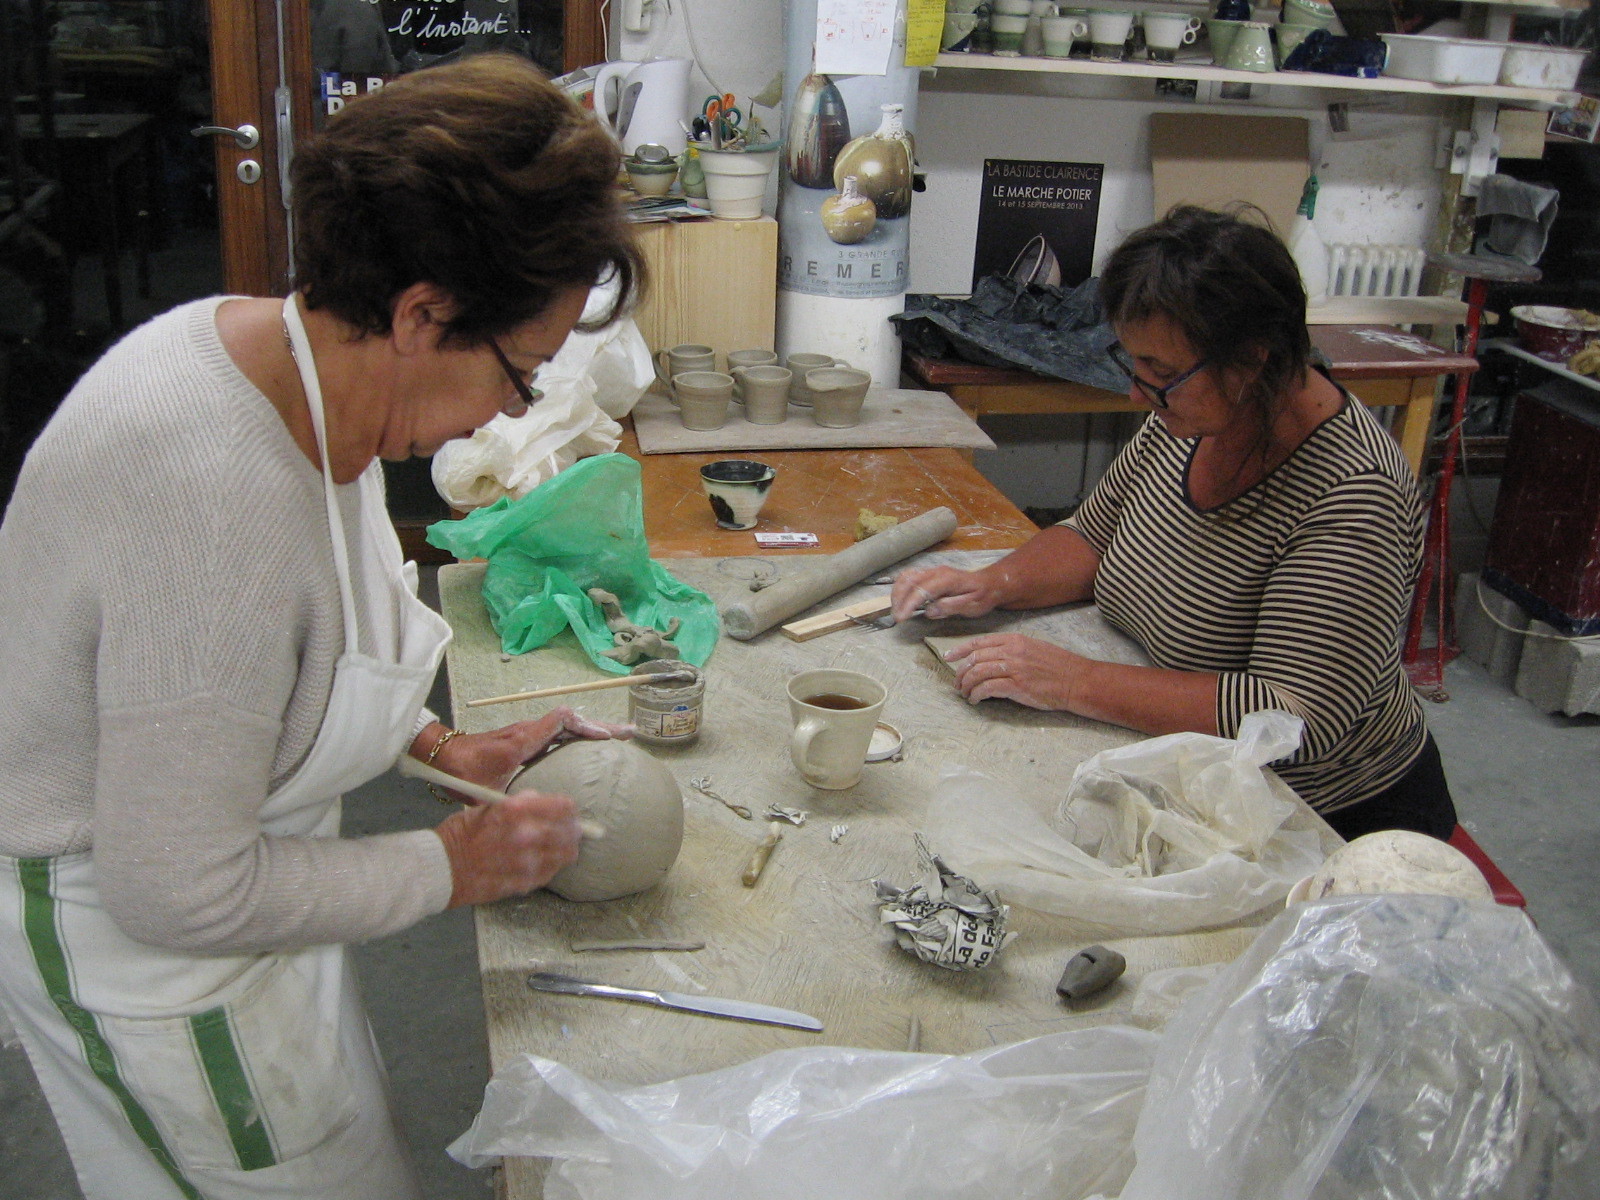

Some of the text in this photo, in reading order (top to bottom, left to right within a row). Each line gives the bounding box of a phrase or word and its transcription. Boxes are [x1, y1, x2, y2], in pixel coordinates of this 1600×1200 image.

[326, 76, 357, 96] La
[988, 164, 1100, 181] LA BASTIDE CLAIRENCE
[992, 185, 1092, 200] LE MARCHE POTIER
[1027, 201, 1066, 209] SEPTEMBRE
